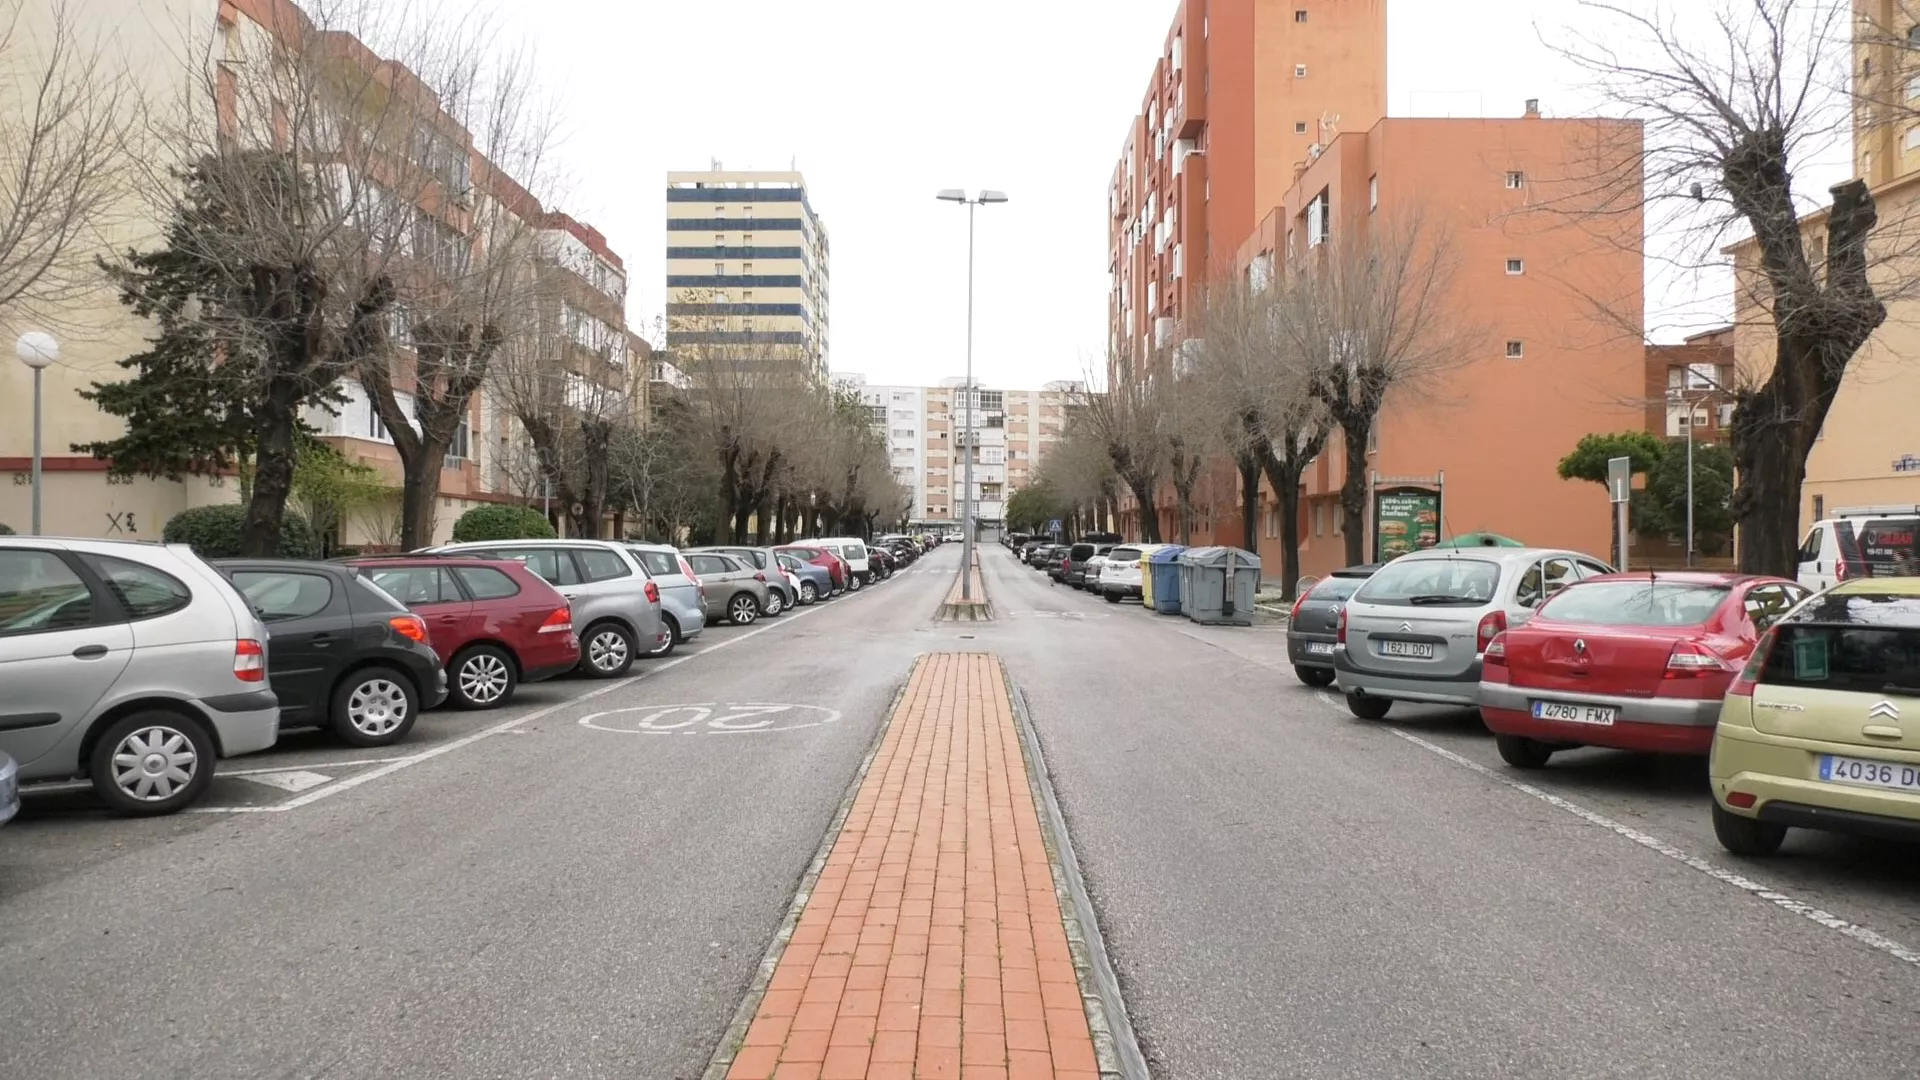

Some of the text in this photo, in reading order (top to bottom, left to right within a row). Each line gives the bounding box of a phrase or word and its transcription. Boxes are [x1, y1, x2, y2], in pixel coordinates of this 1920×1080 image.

[1386, 642, 1407, 654] 1621
[1545, 704, 1612, 723] 4780 FMX
[1835, 760, 1920, 787] 4036 D
